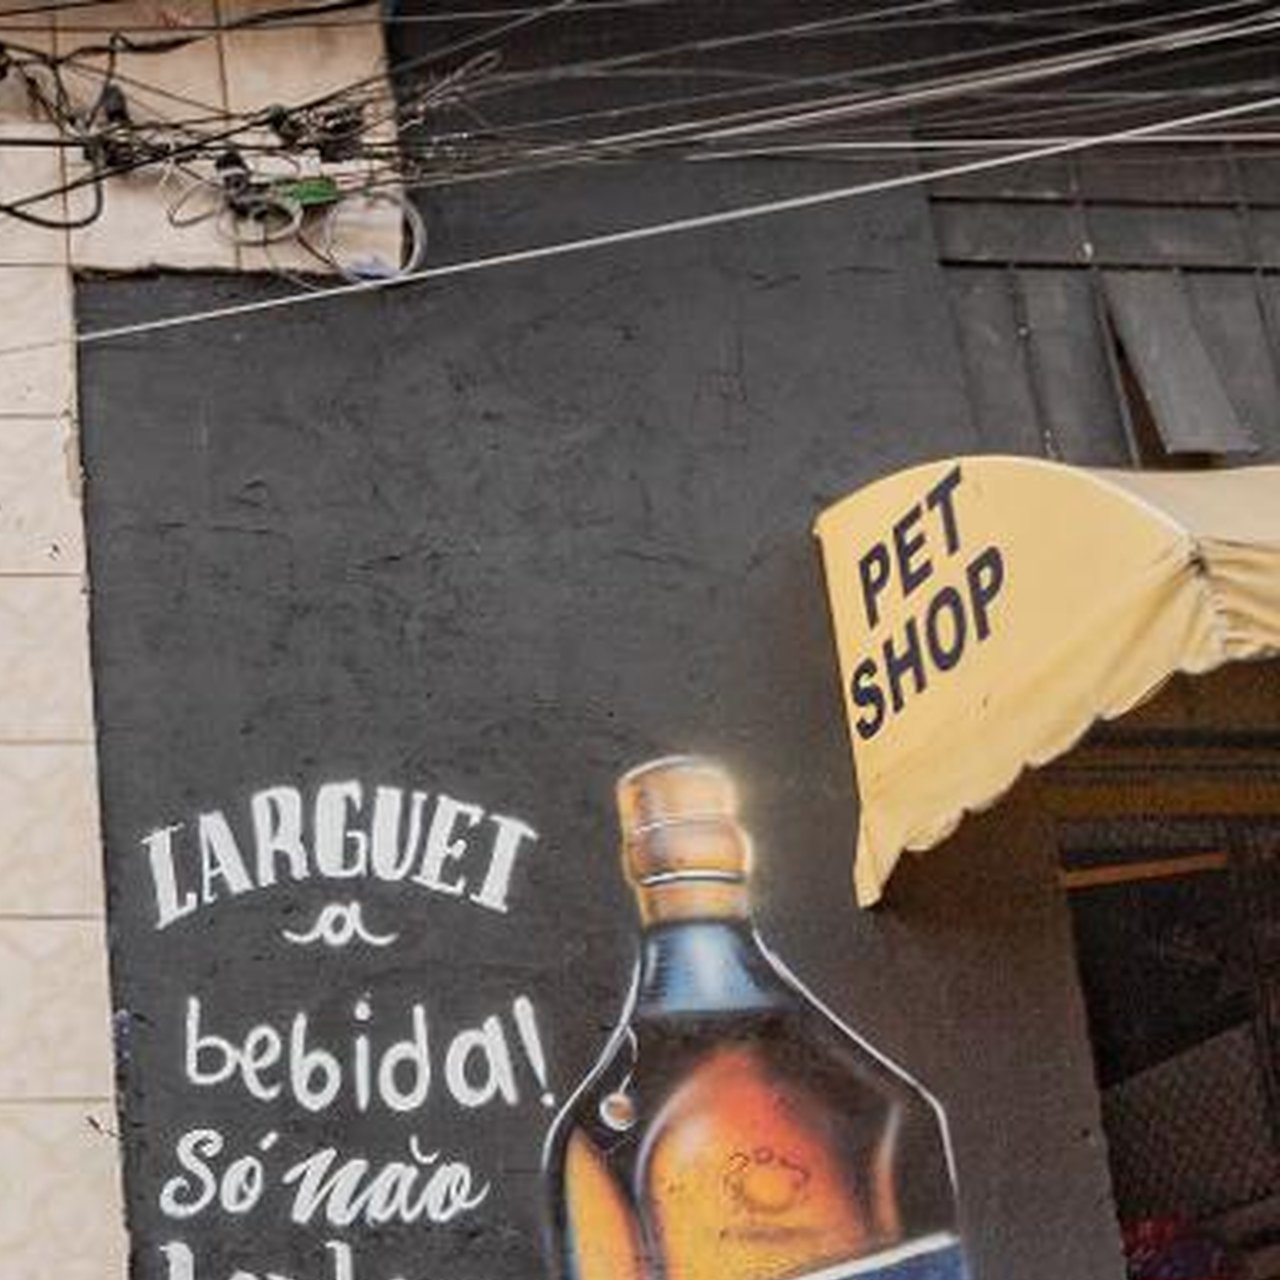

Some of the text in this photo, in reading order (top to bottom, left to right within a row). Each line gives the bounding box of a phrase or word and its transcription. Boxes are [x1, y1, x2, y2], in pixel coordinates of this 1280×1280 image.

[859, 466, 962, 630] PET
[850, 546, 1004, 740] SHOP
[283, 900, 398, 946] a
[185, 995, 556, 1112] bebida!
[160, 1127, 278, 1219] Só
